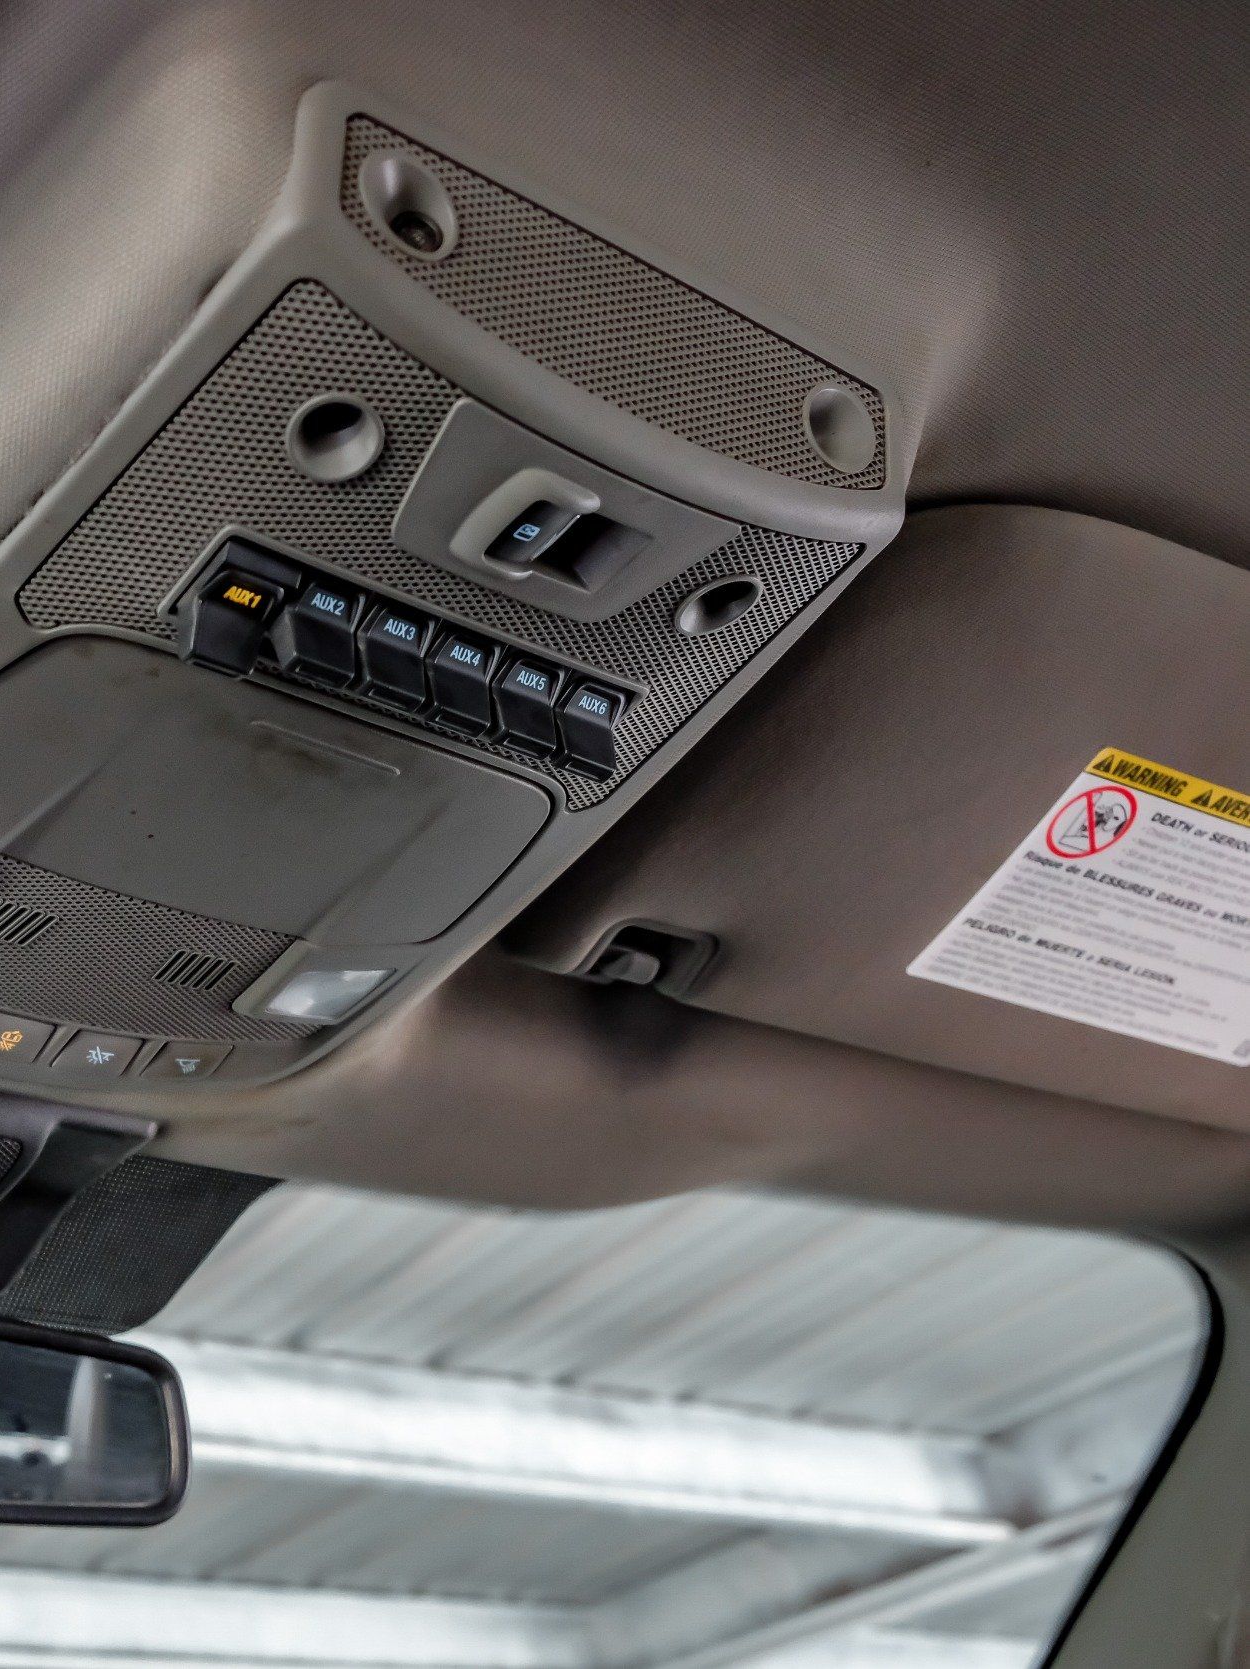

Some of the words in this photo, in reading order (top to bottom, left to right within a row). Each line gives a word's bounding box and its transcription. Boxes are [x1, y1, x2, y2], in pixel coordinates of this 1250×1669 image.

[223, 585, 262, 608] AUX1
[310, 592, 345, 616] AUX2
[383, 618, 416, 641] AUX3
[449, 645, 481, 667] AUX4
[516, 670, 547, 691] AUX5
[578, 695, 608, 715] AUX6
[1112, 758, 1189, 798] WARNING
[1151, 812, 1194, 833] DEATH
[1083, 868, 1155, 897] BLESSURES
